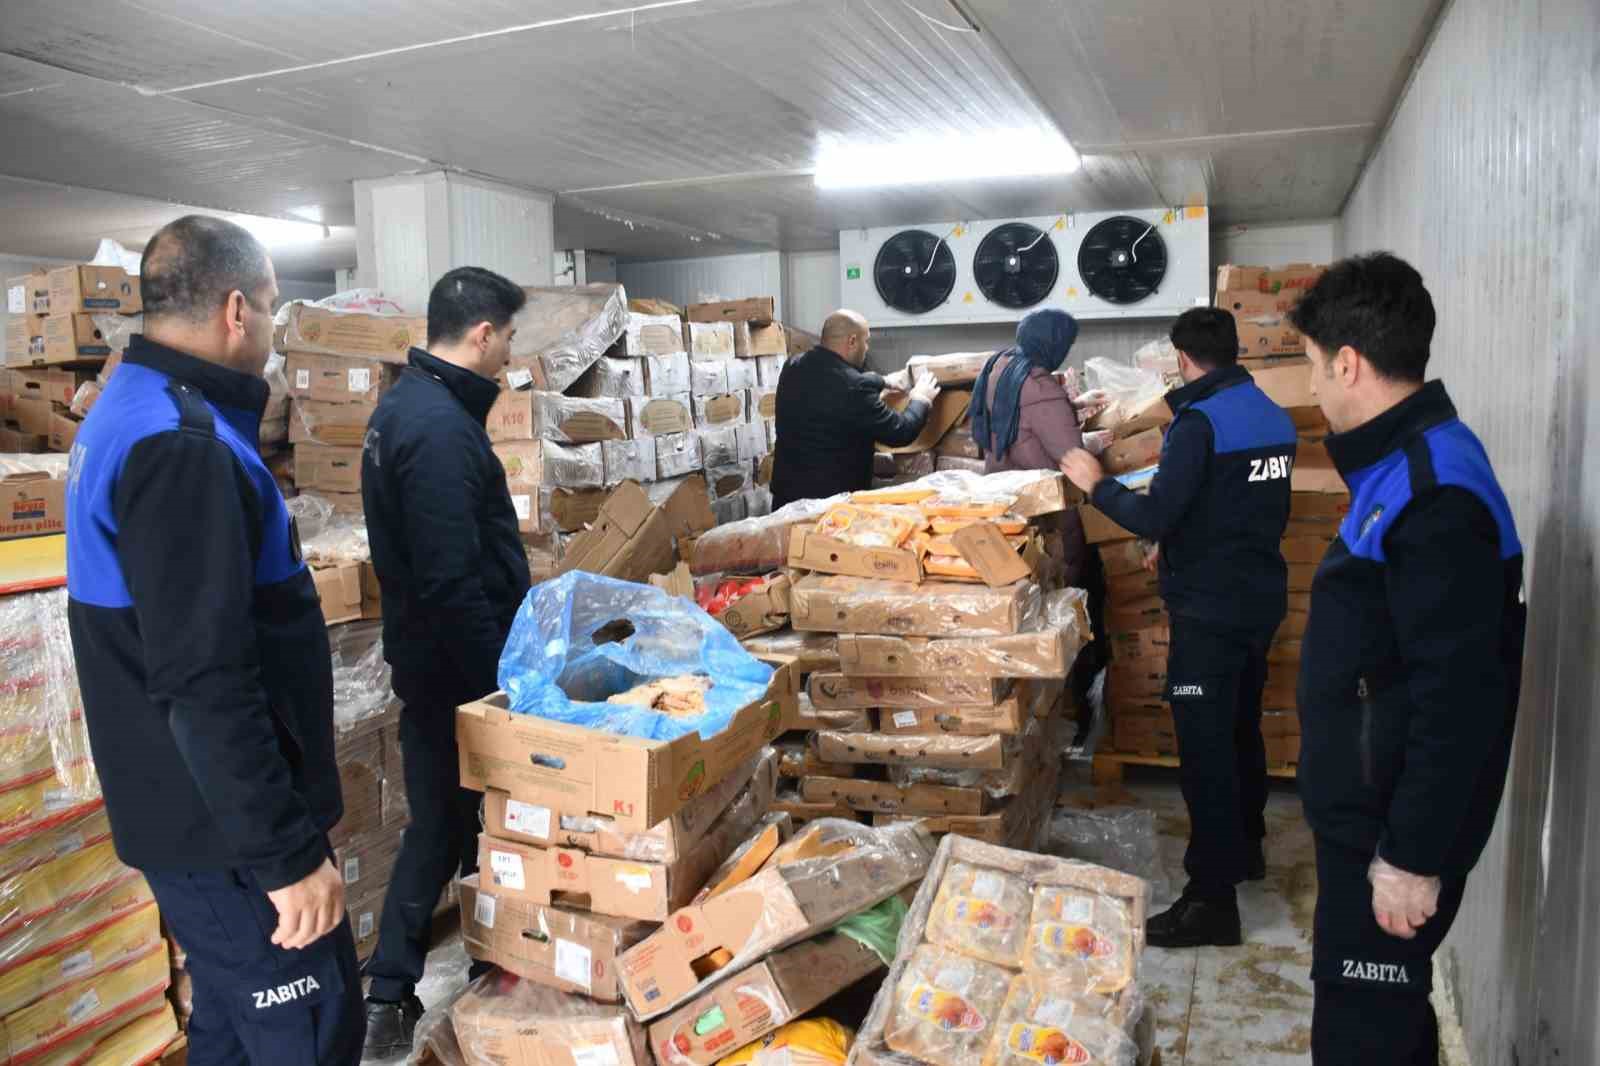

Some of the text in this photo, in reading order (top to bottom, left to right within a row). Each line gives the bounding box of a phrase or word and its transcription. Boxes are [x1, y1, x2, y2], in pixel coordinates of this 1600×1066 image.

[1248, 456, 1289, 481] ZABI
[1173, 685, 1203, 696] ZABITA
[1342, 959, 1409, 983] ZABITA
[252, 975, 321, 1009] ZABITA
